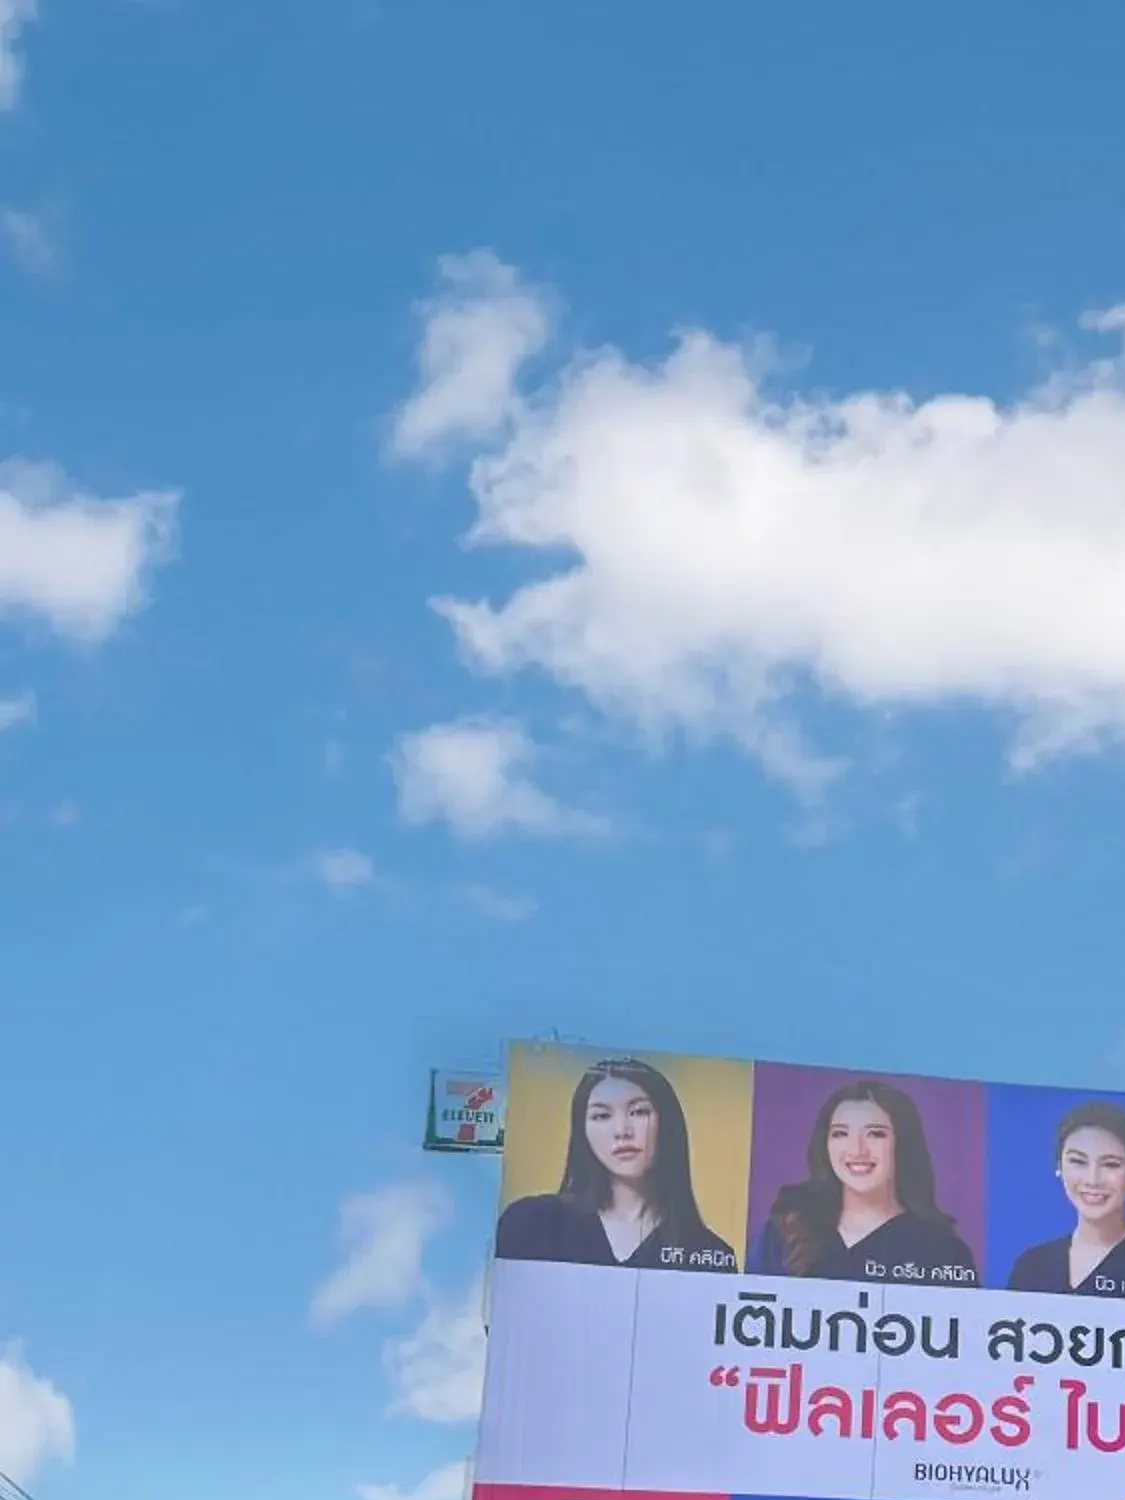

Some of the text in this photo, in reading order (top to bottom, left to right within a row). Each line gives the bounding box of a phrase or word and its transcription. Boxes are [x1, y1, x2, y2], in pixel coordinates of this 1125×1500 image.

[931, 1264, 975, 1281] คลินิก
[714, 1291, 959, 1359] เติมก่อน
[709, 1363, 1035, 1447] “ฟิลเลอร์
[914, 1463, 1030, 1490] BIOHYALUX
